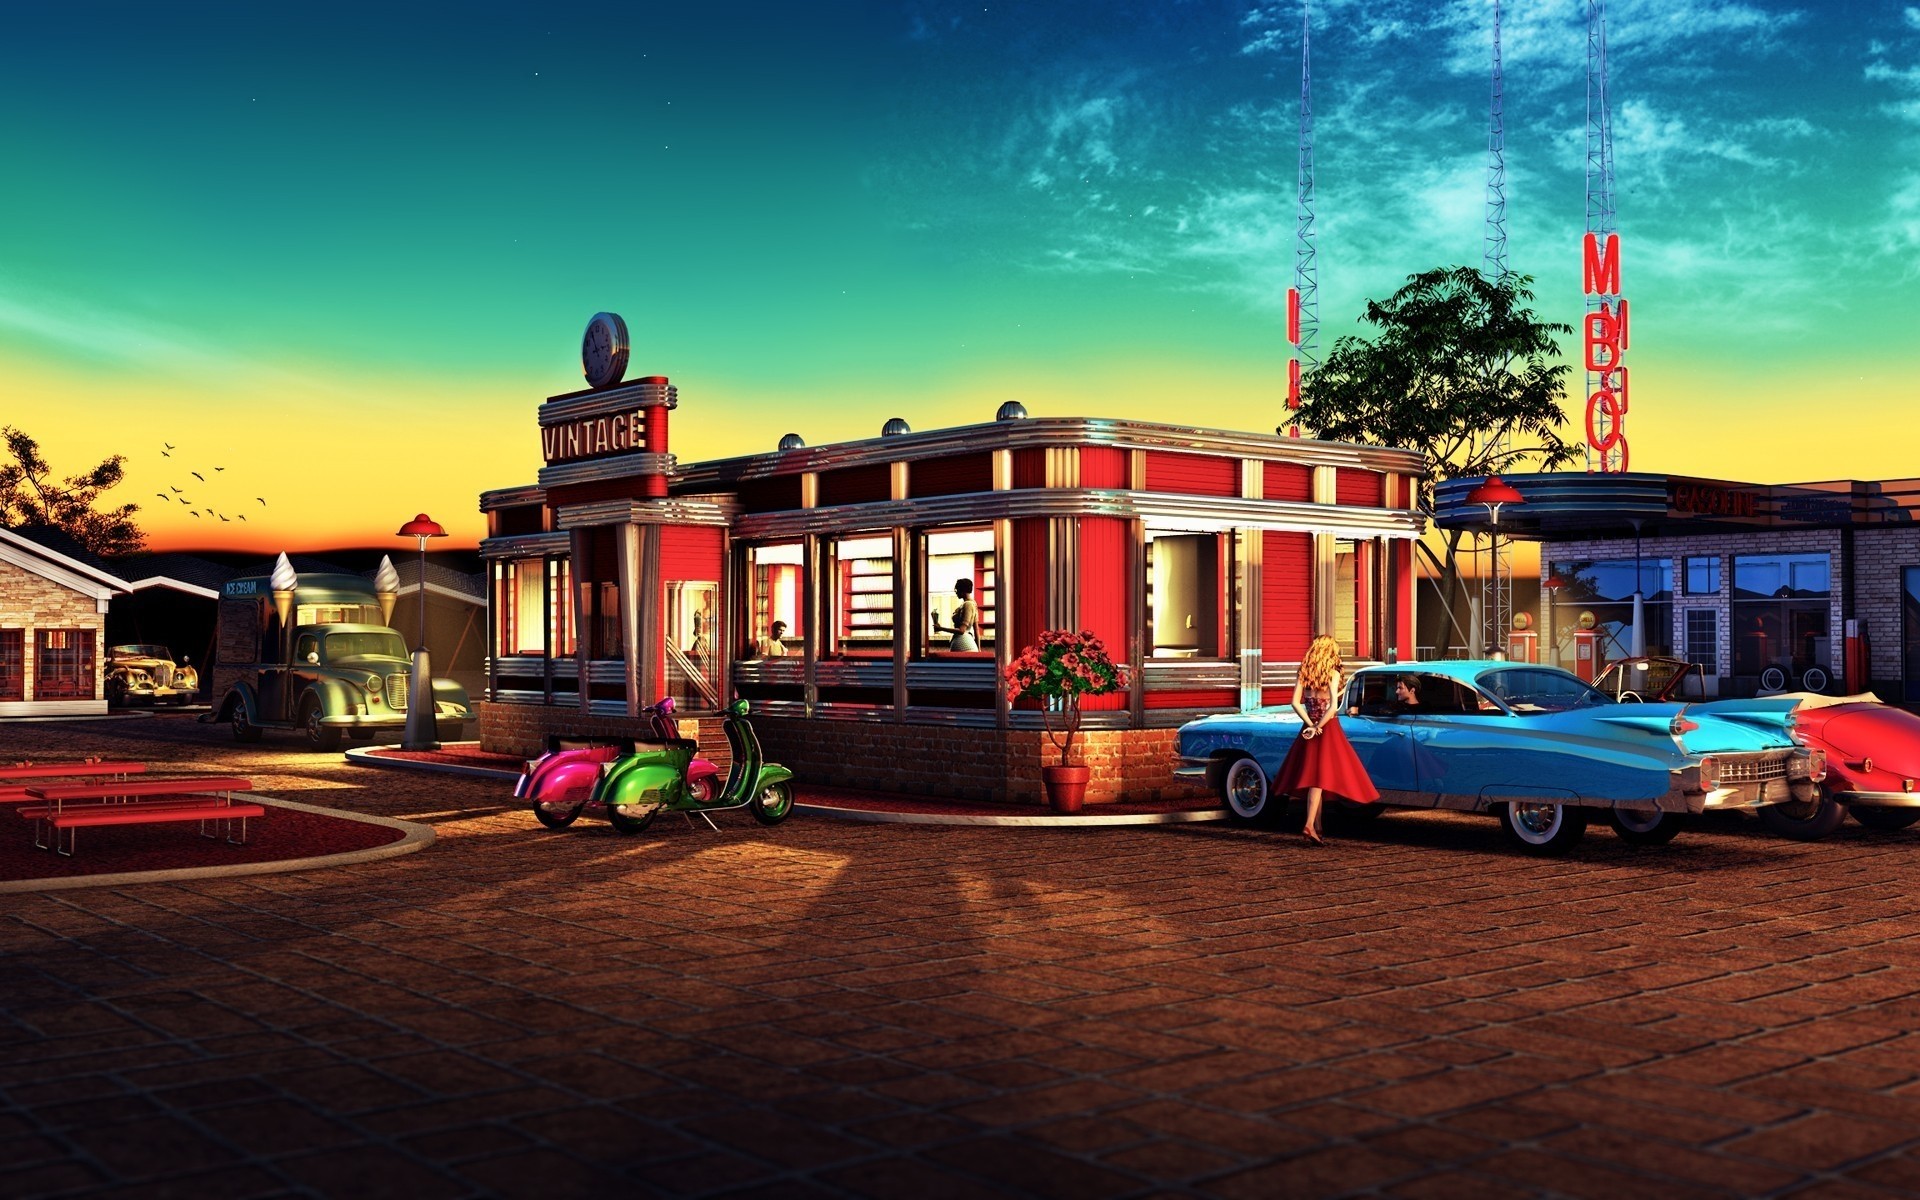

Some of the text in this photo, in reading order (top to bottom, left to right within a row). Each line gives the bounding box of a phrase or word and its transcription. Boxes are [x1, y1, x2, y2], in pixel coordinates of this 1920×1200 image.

[1584, 233, 1620, 473] MBO
[543, 410, 646, 461] VINTAGE
[1676, 485, 1761, 517] GASOLINE
[226, 581, 257, 595] ICE CREAM
